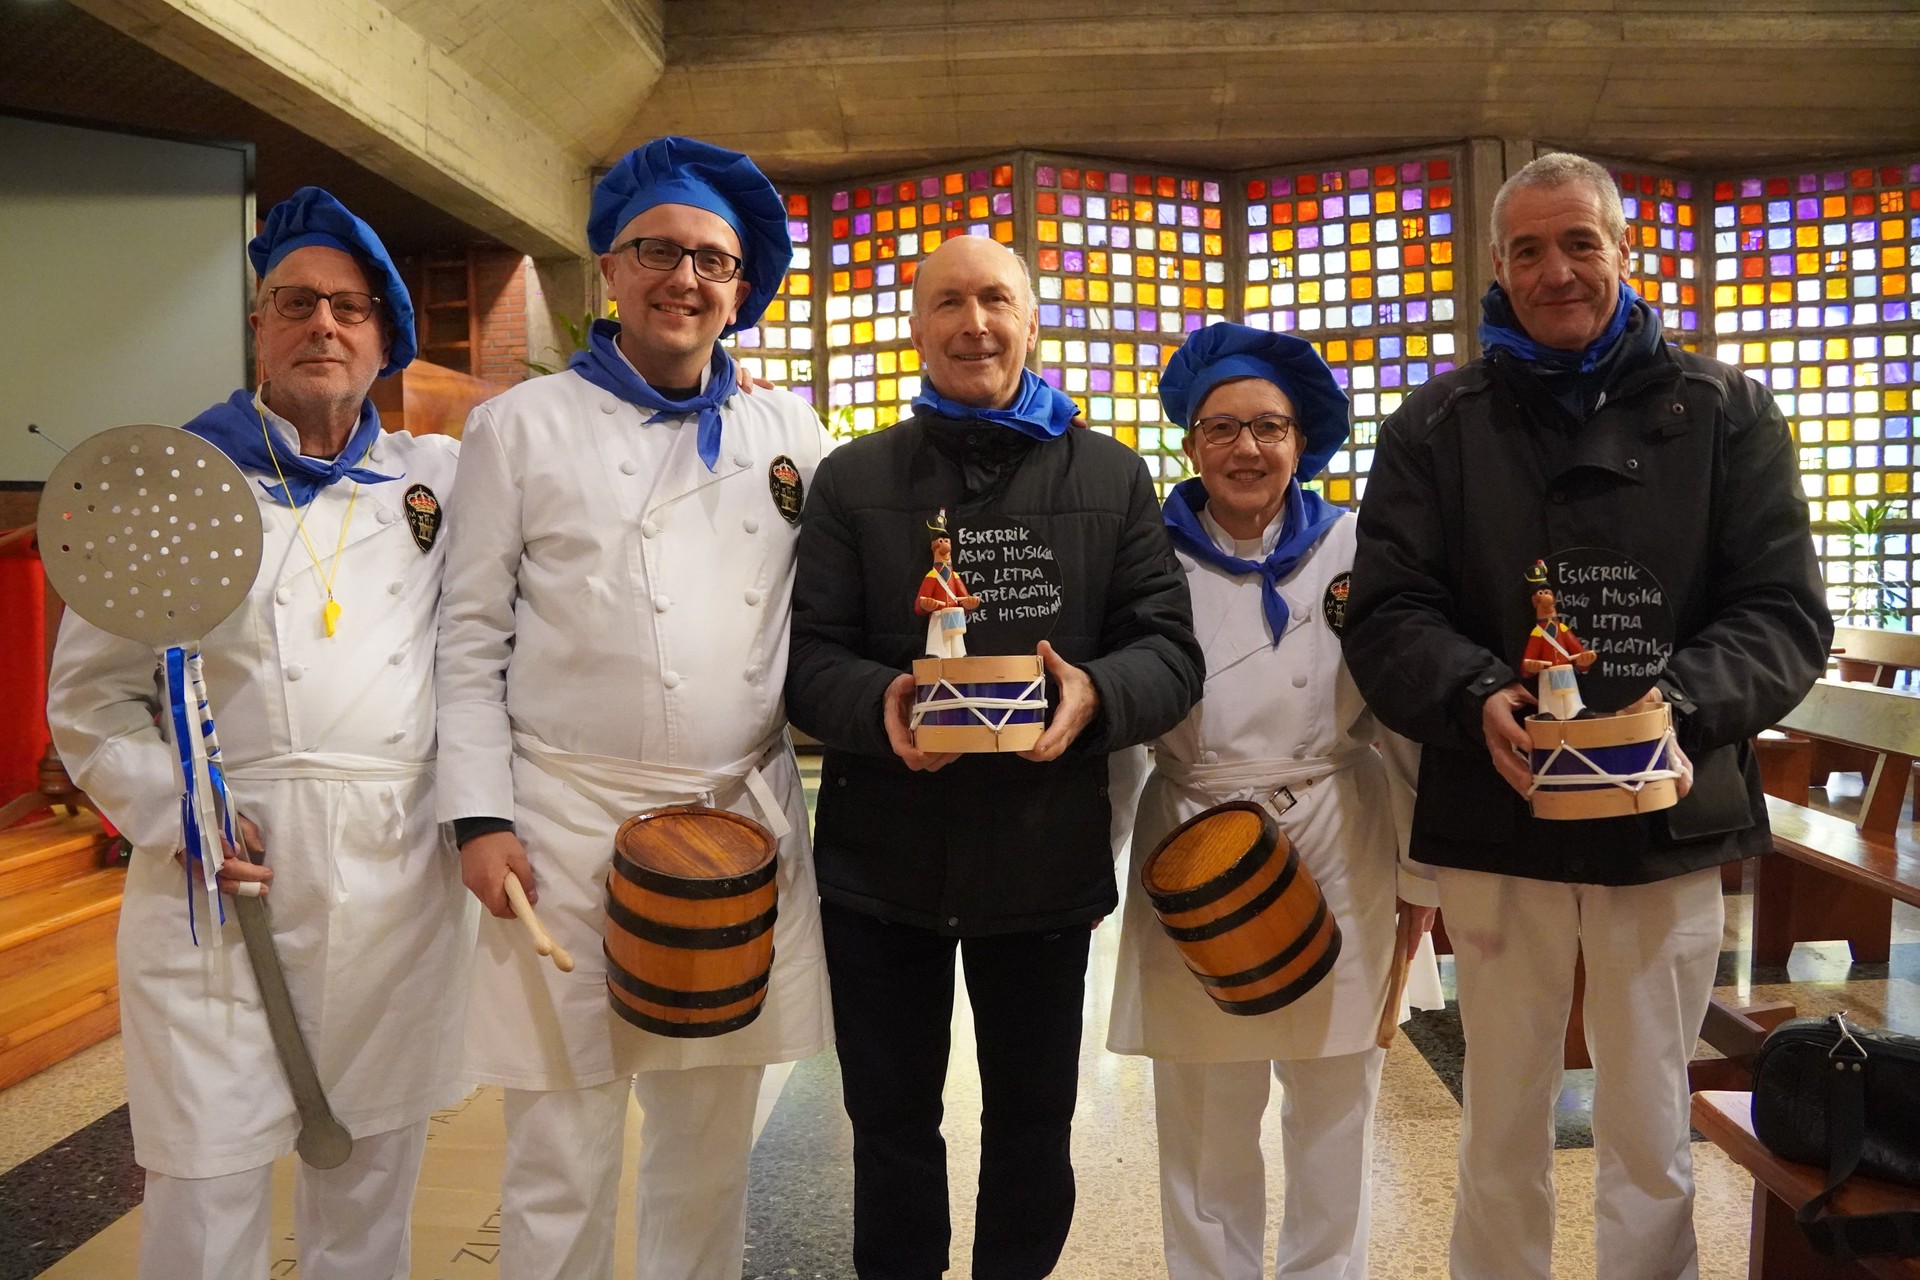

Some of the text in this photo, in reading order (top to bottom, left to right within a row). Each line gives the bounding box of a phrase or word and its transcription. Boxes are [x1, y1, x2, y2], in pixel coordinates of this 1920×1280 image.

[957, 526, 1031, 546] ESKERRIK
[957, 548, 996, 565] ASKO
[957, 567, 1044, 585] TA LETRA
[1558, 560, 1641, 585] ESKERRIK
[971, 580, 1062, 604] RTZEAGATIK
[1557, 612, 1643, 632] TA LETRA
